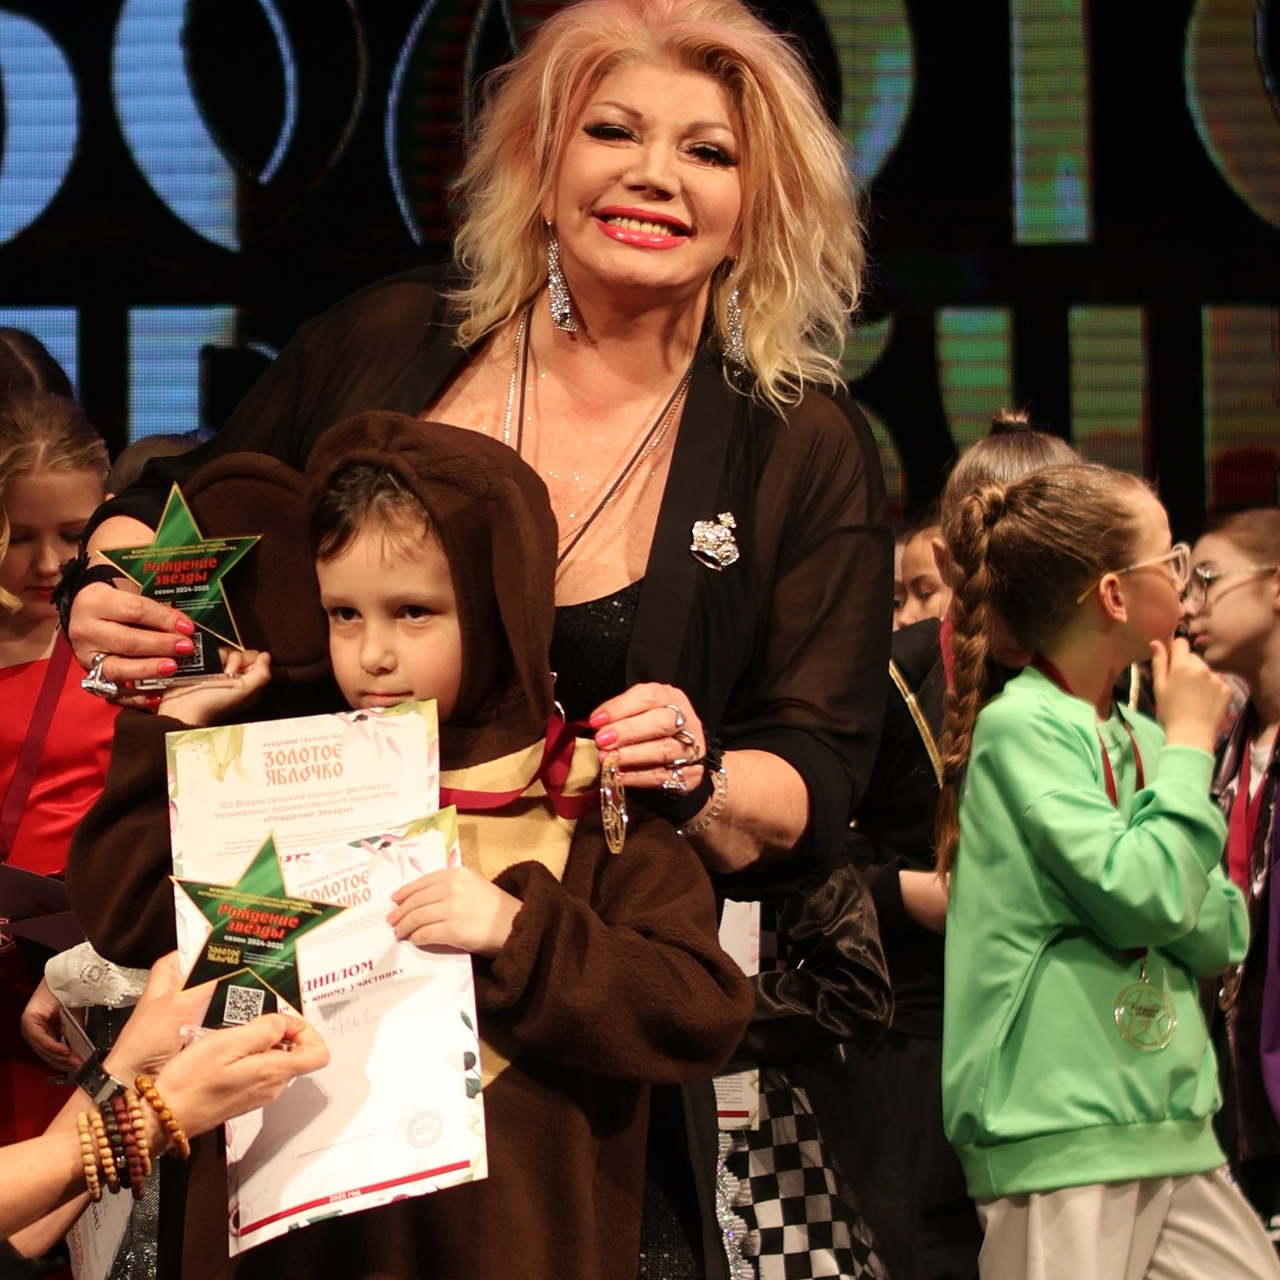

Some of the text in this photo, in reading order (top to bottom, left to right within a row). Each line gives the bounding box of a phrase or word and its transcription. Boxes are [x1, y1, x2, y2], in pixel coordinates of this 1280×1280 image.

[143, 558, 218, 574] Рождение
[176, 584, 210, 594] 2024-2025
[263, 742, 342, 768] ЗОЛОТОЕ
[265, 761, 344, 787] ЯБЛОЧКО
[219, 782, 392, 810] 102 Всероссийский конкурс-фестиваль
[350, 790, 398, 804] творчества
[263, 810, 314, 823] «Рождение
[218, 902, 300, 929] Рождение
[226, 920, 287, 940] звезды
[224, 935, 284, 950] сезон 2024-2025
[302, 959, 374, 993] ДИПЛОМ
[312, 987, 346, 1002] юному
[350, 968, 404, 992] участнику
